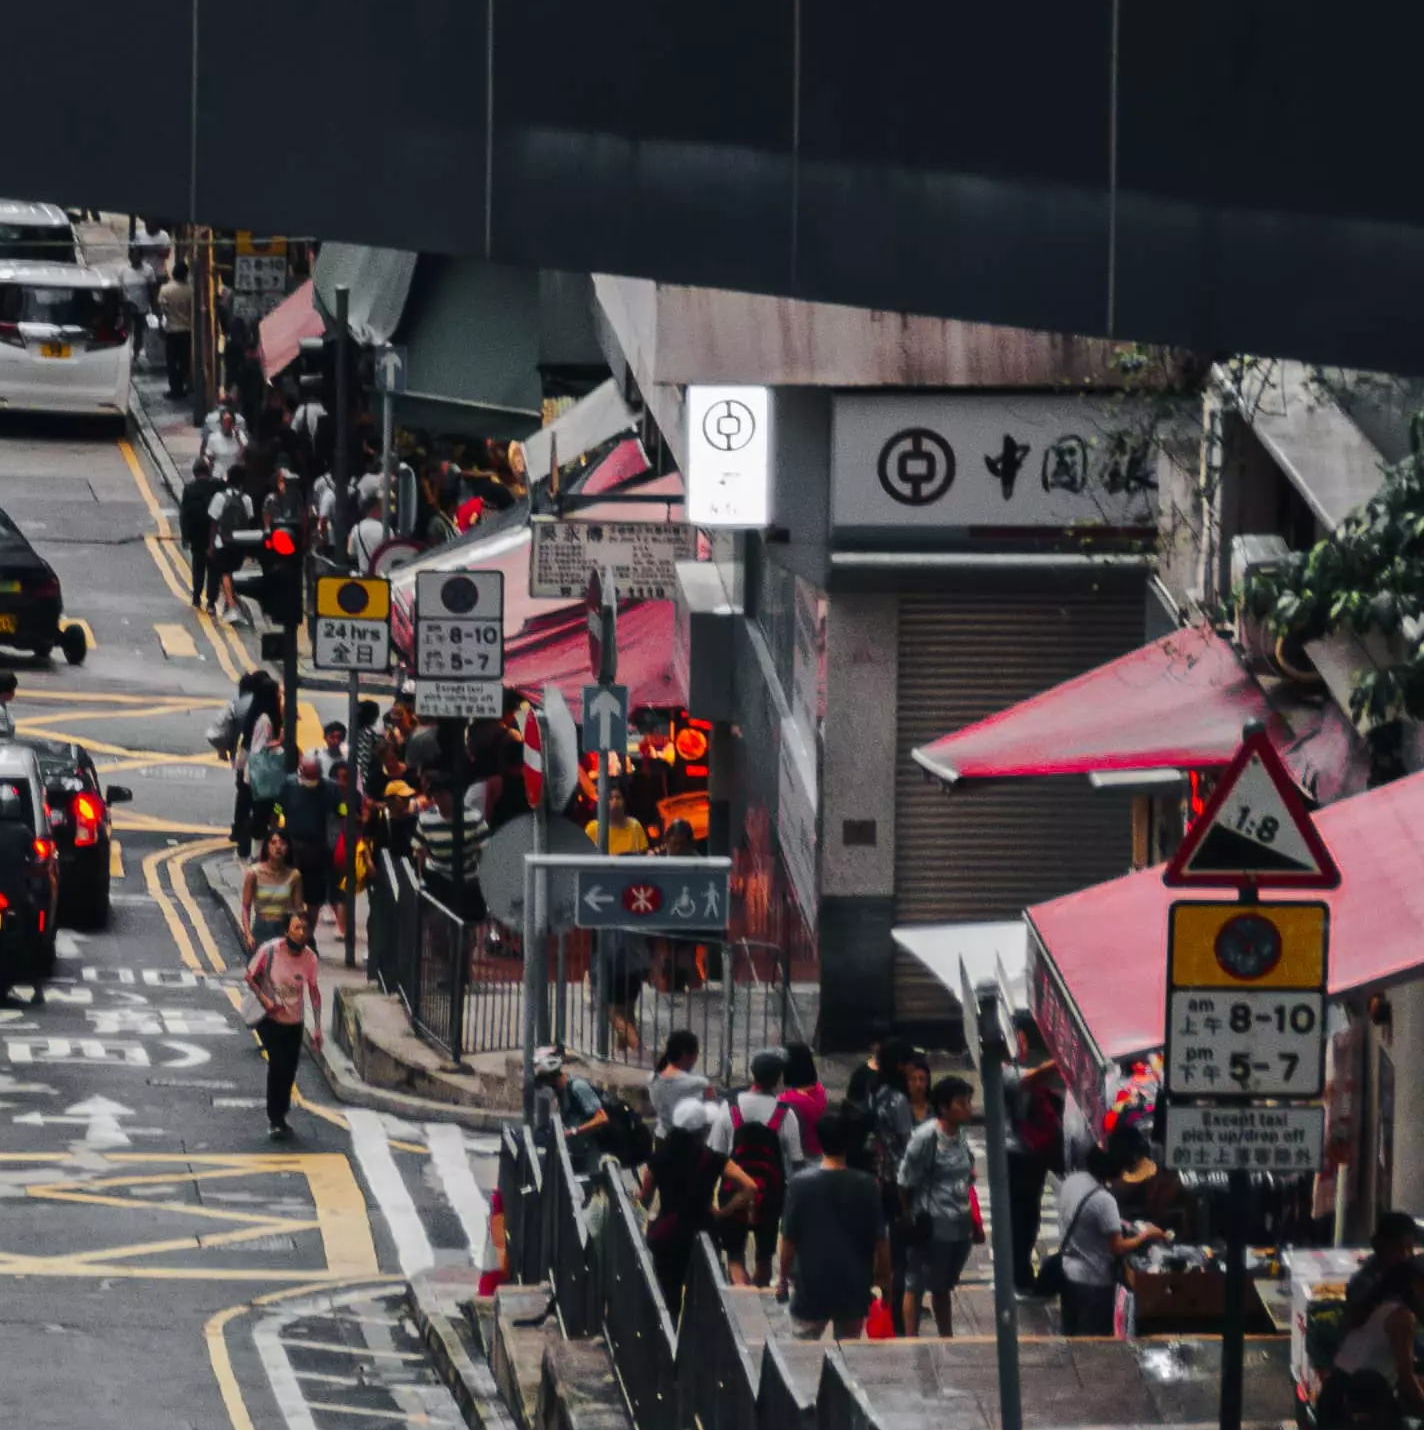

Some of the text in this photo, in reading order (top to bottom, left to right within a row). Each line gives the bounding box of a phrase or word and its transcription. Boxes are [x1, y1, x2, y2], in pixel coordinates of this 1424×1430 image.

[324, 622, 380, 641] 24 hrs
[450, 626, 497, 644] 8-10
[330, 643, 374, 664] 全日
[451, 653, 488, 671] 5-7
[1236, 806, 1280, 843] 1:8
[1188, 1000, 1214, 1012] am
[1179, 1015, 1223, 1036] 上午
[1229, 1003, 1316, 1036] 8-10
[1186, 1046, 1213, 1062] pm
[1179, 1062, 1221, 1084] 下午
[1229, 1052, 1300, 1083] 5-7
[1202, 1111, 1288, 1128] Except taxi
[1182, 1128, 1305, 1147] pick up/drop off
